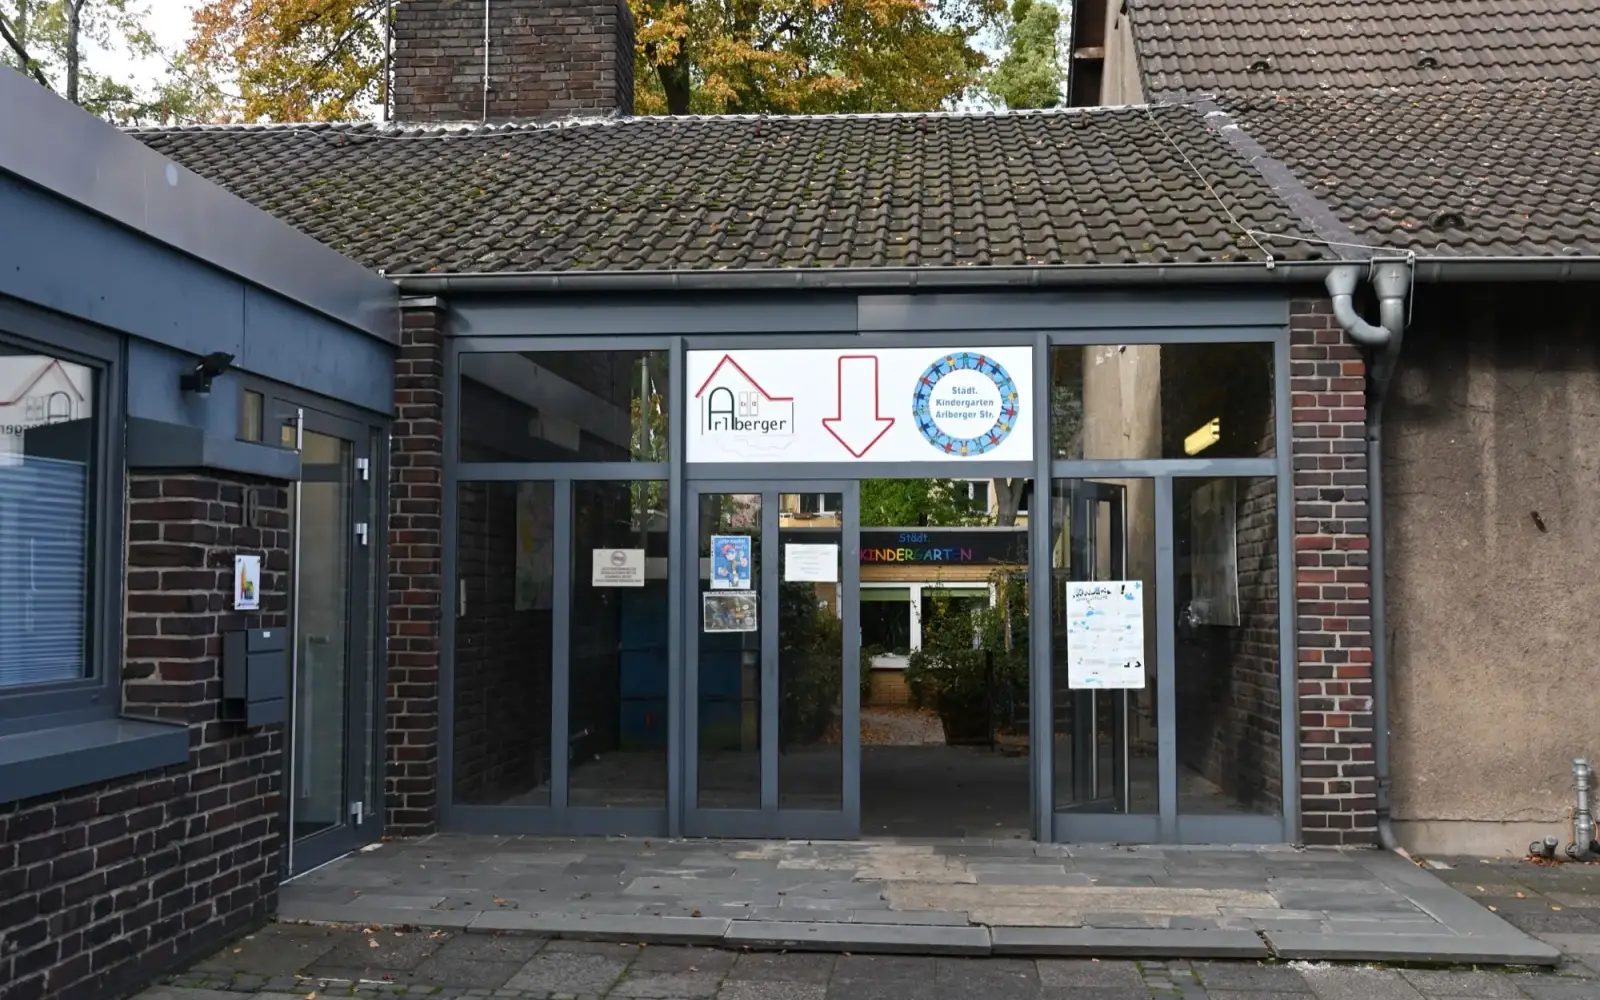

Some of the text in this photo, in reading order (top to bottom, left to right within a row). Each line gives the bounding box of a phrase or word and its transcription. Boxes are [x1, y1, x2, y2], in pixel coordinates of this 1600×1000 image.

[936, 399, 994, 408] Kindergarten
[708, 386, 787, 434] Arlberger
[936, 410, 995, 420] Arlberger Str.
